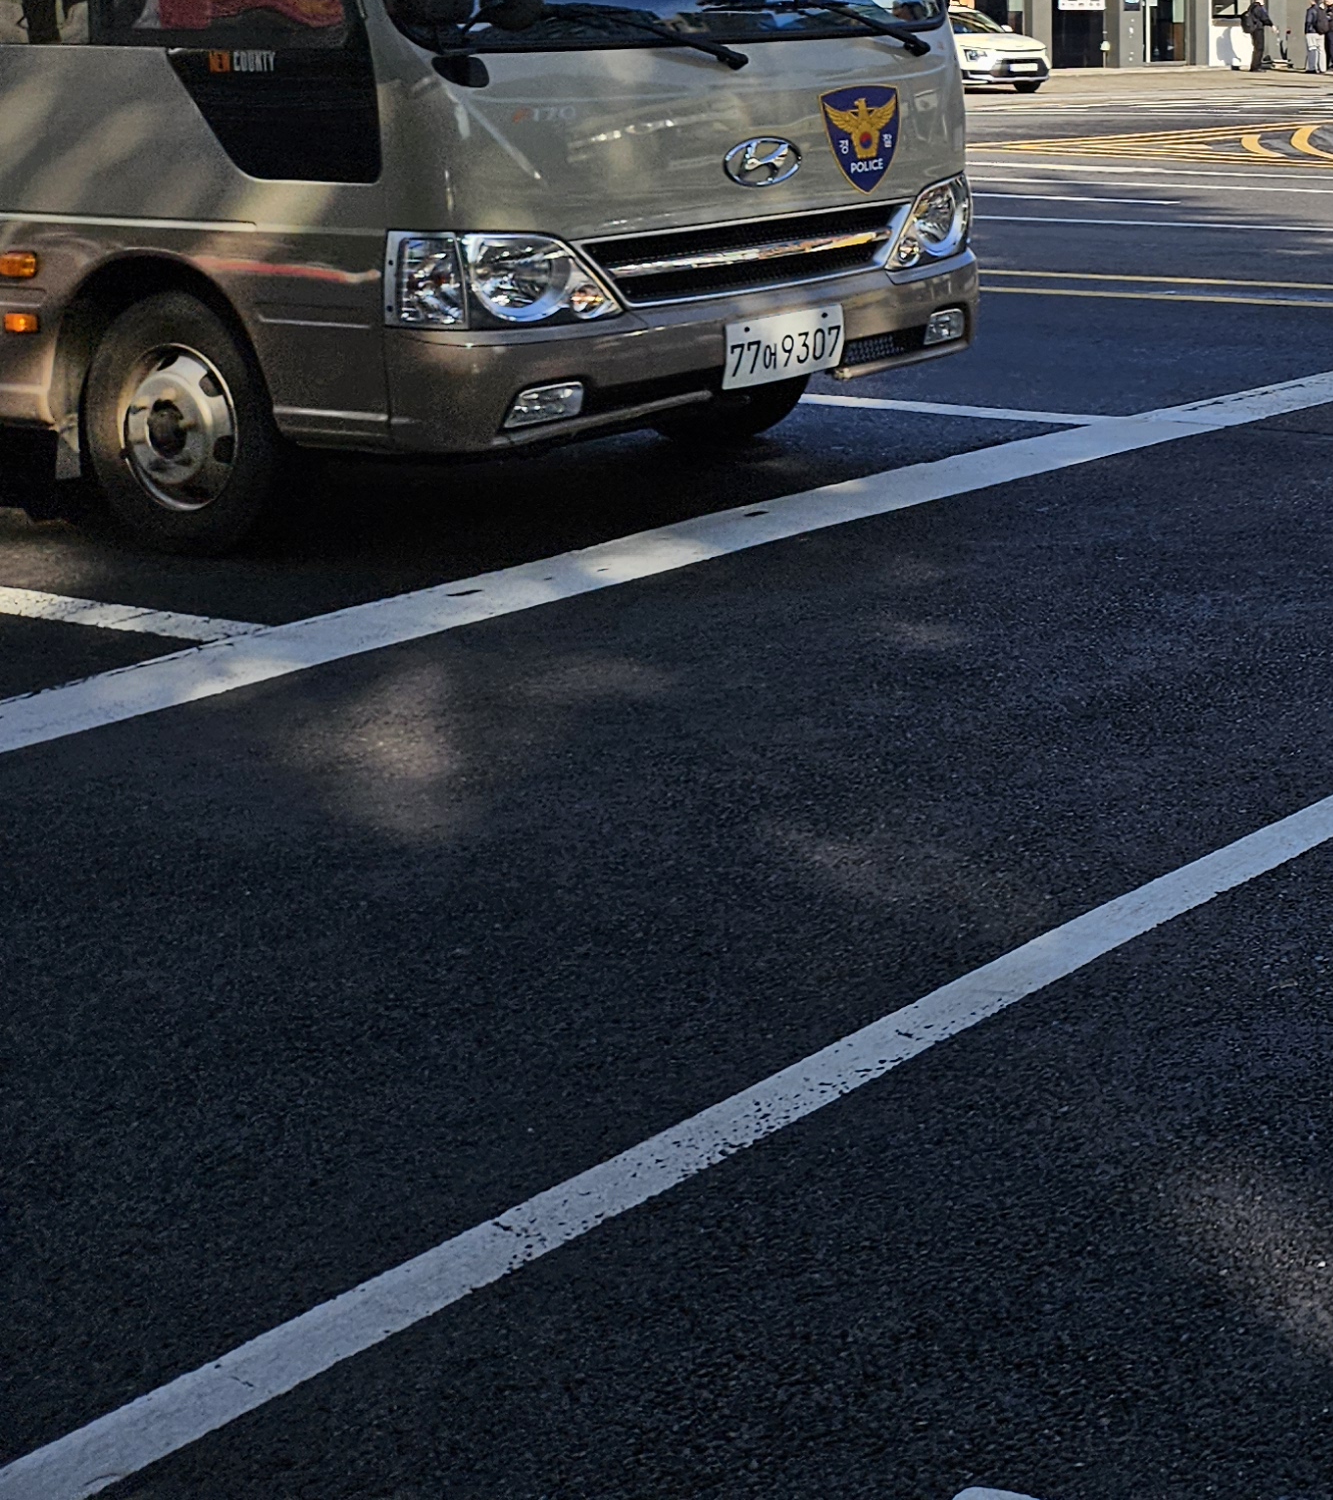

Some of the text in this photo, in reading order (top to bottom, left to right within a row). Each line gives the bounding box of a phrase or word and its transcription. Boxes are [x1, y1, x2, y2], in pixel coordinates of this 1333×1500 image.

[233, 50, 276, 72] COUNTY
[839, 140, 849, 154] 경
[850, 158, 883, 174] POLICE
